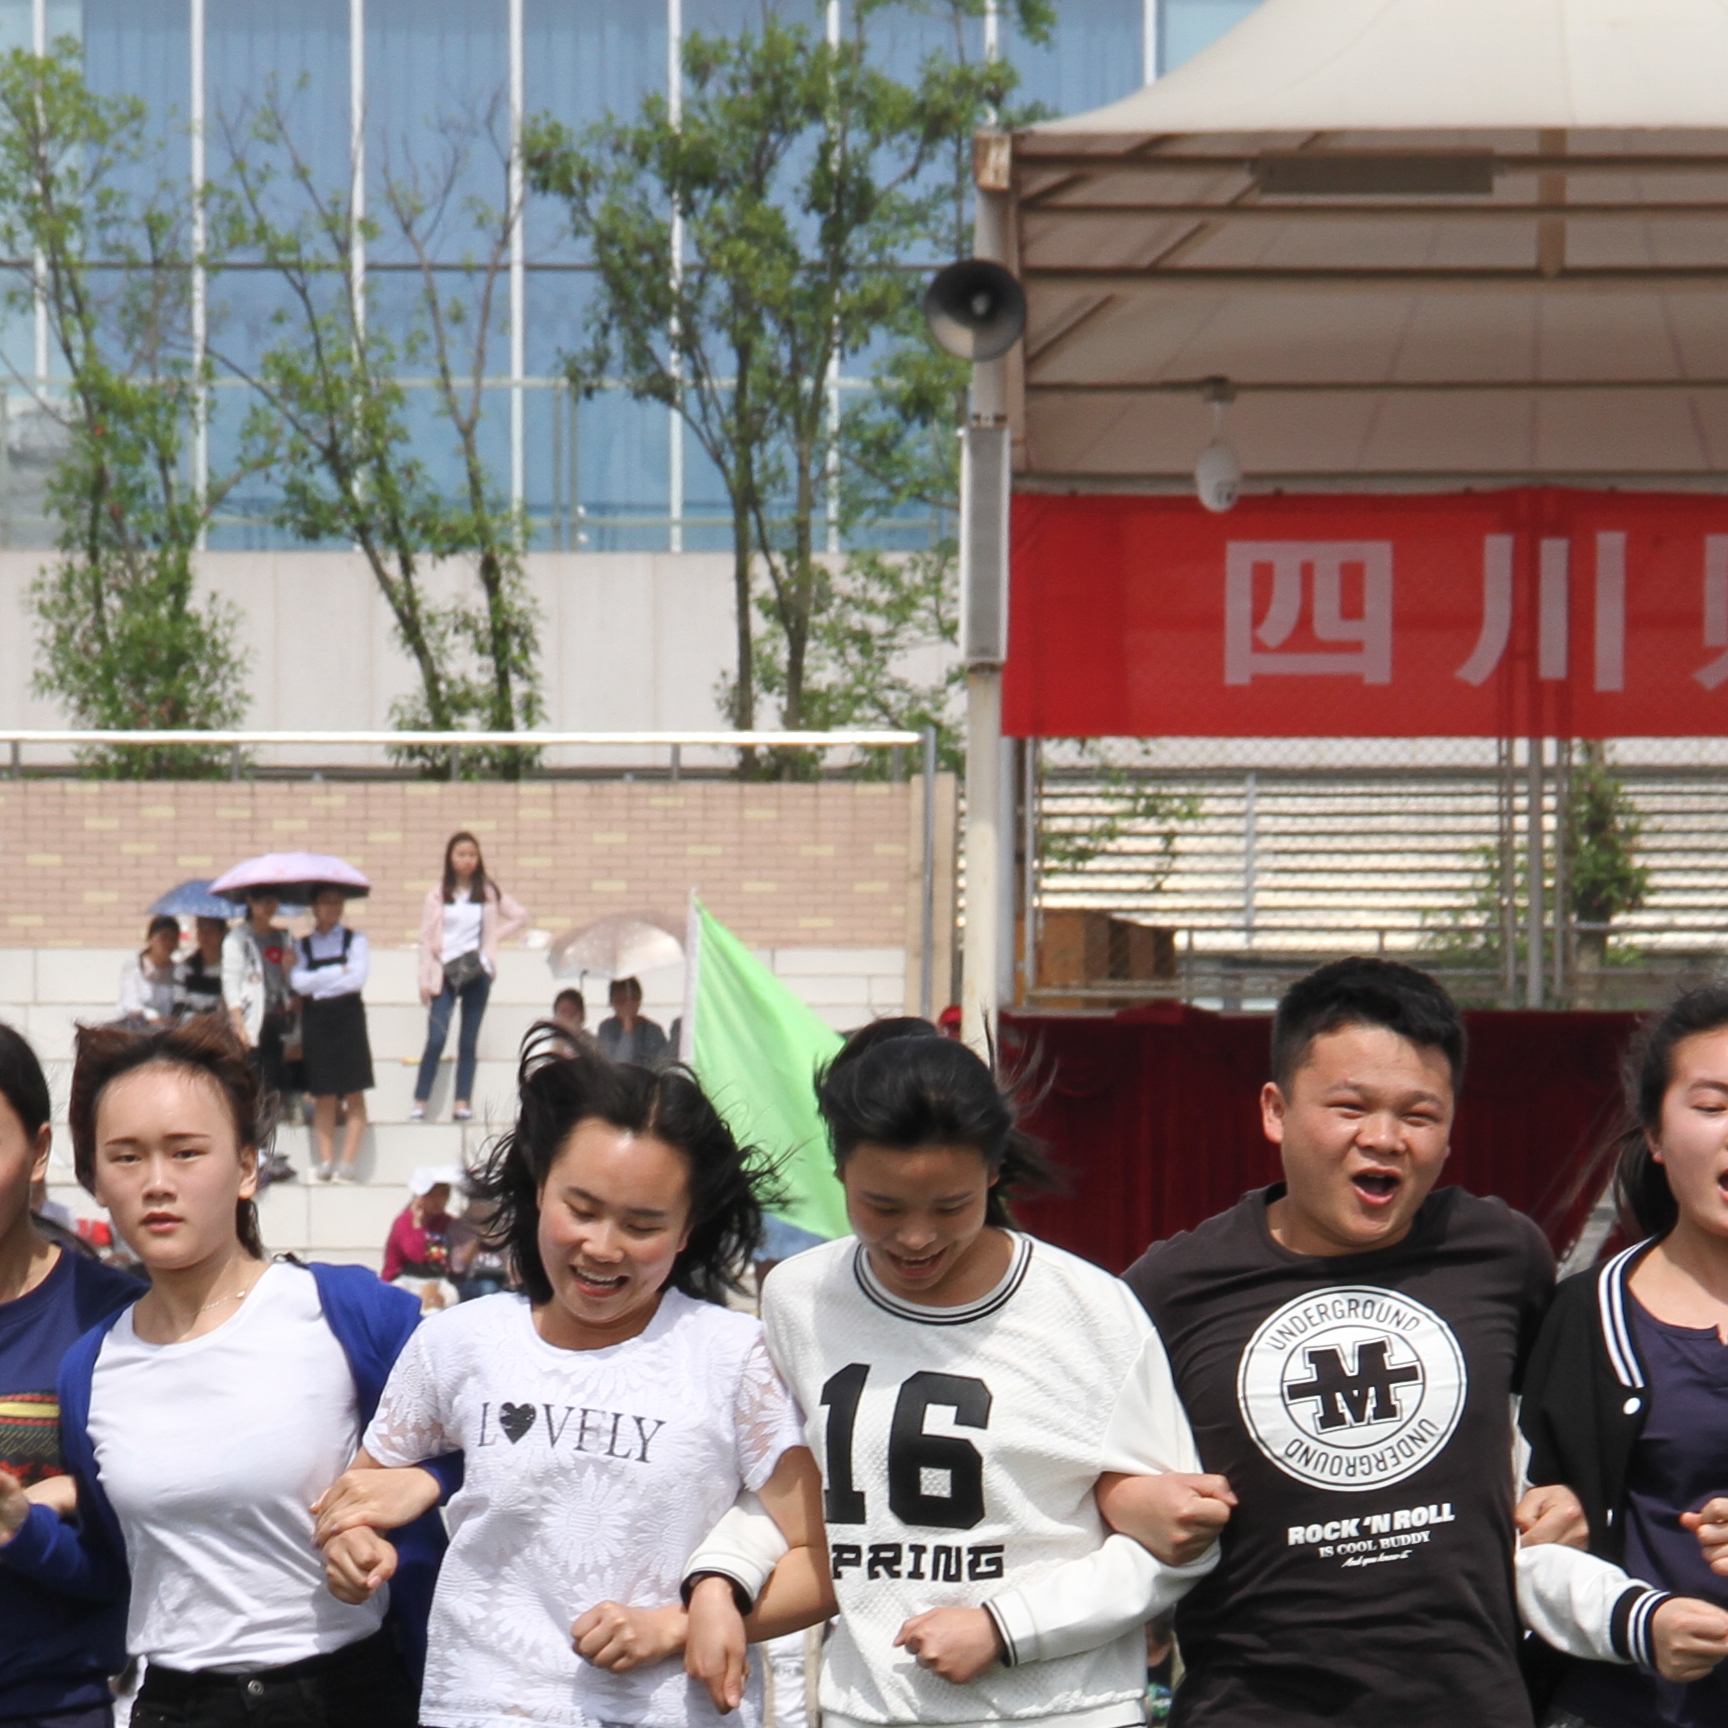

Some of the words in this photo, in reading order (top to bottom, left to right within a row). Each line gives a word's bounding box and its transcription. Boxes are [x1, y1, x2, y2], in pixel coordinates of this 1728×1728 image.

[1266, 1298, 1420, 1351] UNDERGROUND
[819, 1363, 992, 1530] 16
[1285, 1418, 1440, 1477] UNDERGROUND
[1288, 1518, 1360, 1546] ROCK
[1394, 1503, 1455, 1530] ROLL
[1318, 1546, 1335, 1558] IS
[1337, 1540, 1377, 1554] COOL
[1379, 1531, 1431, 1549] BUDDY
[832, 1543, 1005, 1582] PRING
